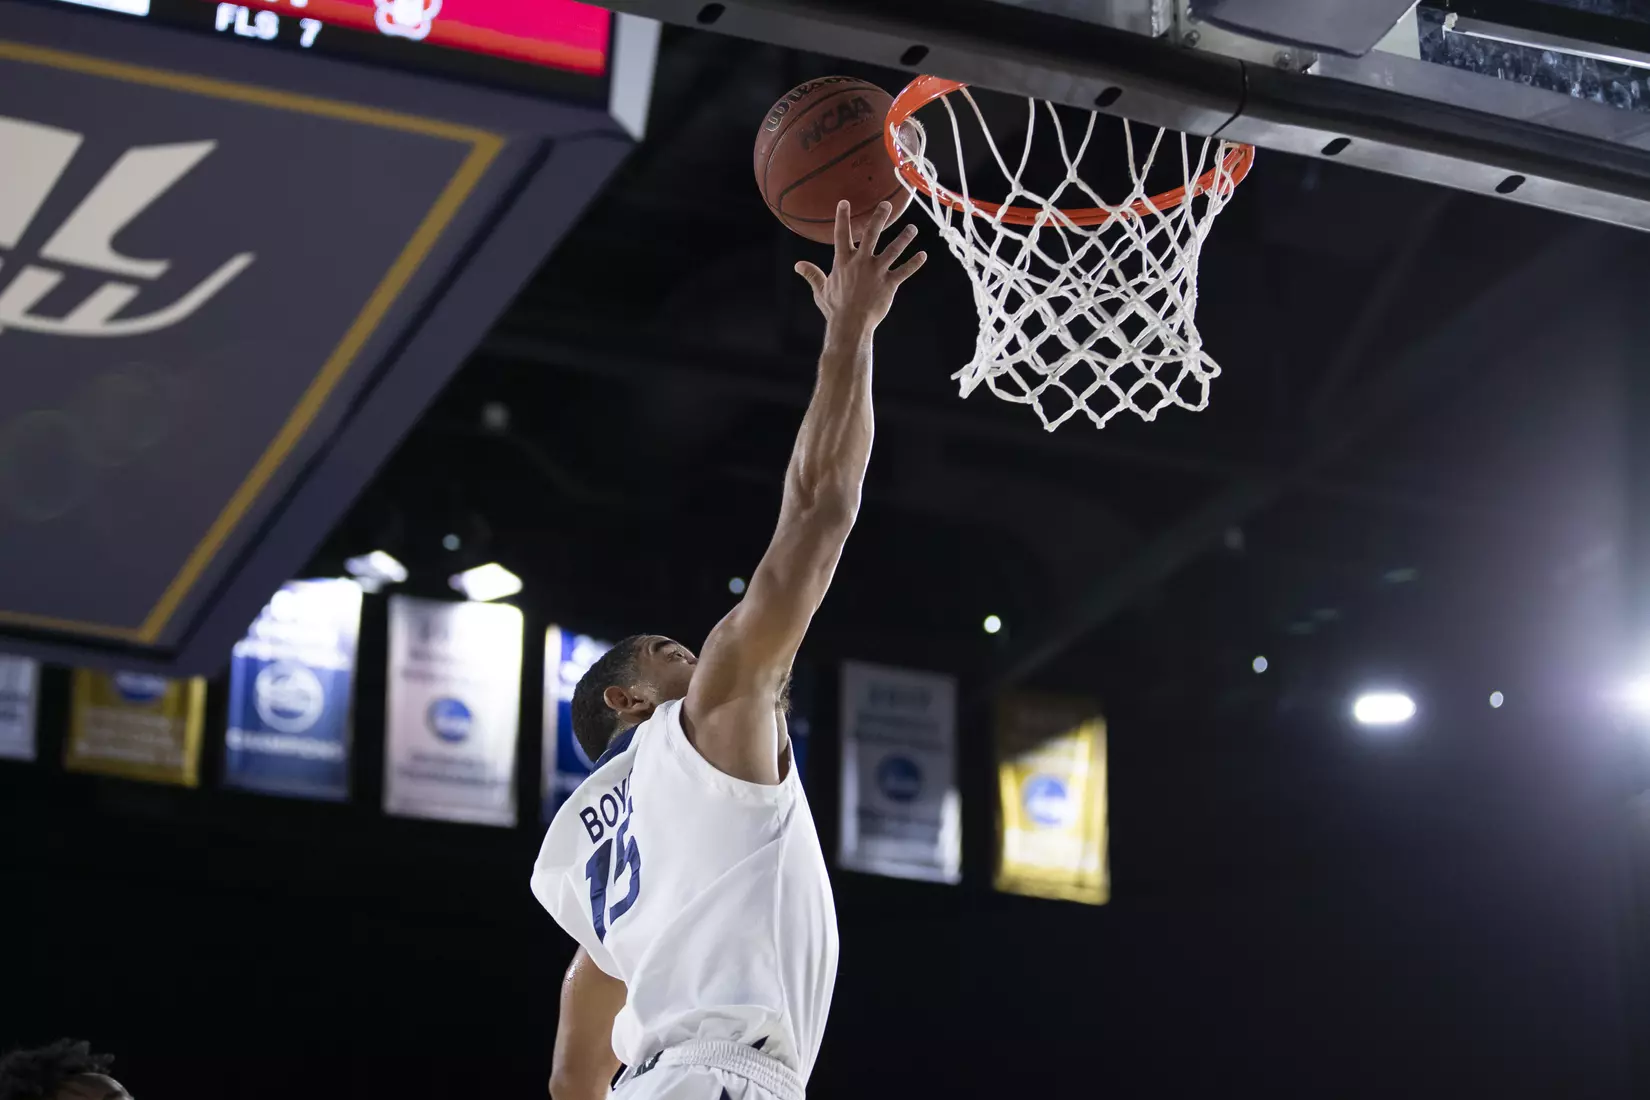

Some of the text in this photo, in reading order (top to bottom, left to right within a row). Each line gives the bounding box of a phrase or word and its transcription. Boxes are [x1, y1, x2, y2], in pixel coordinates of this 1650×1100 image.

[215, 2, 323, 48] FLS 7
[799, 96, 875, 152] NCAA
[579, 767, 633, 845] BOY
[585, 796, 642, 944] 15
